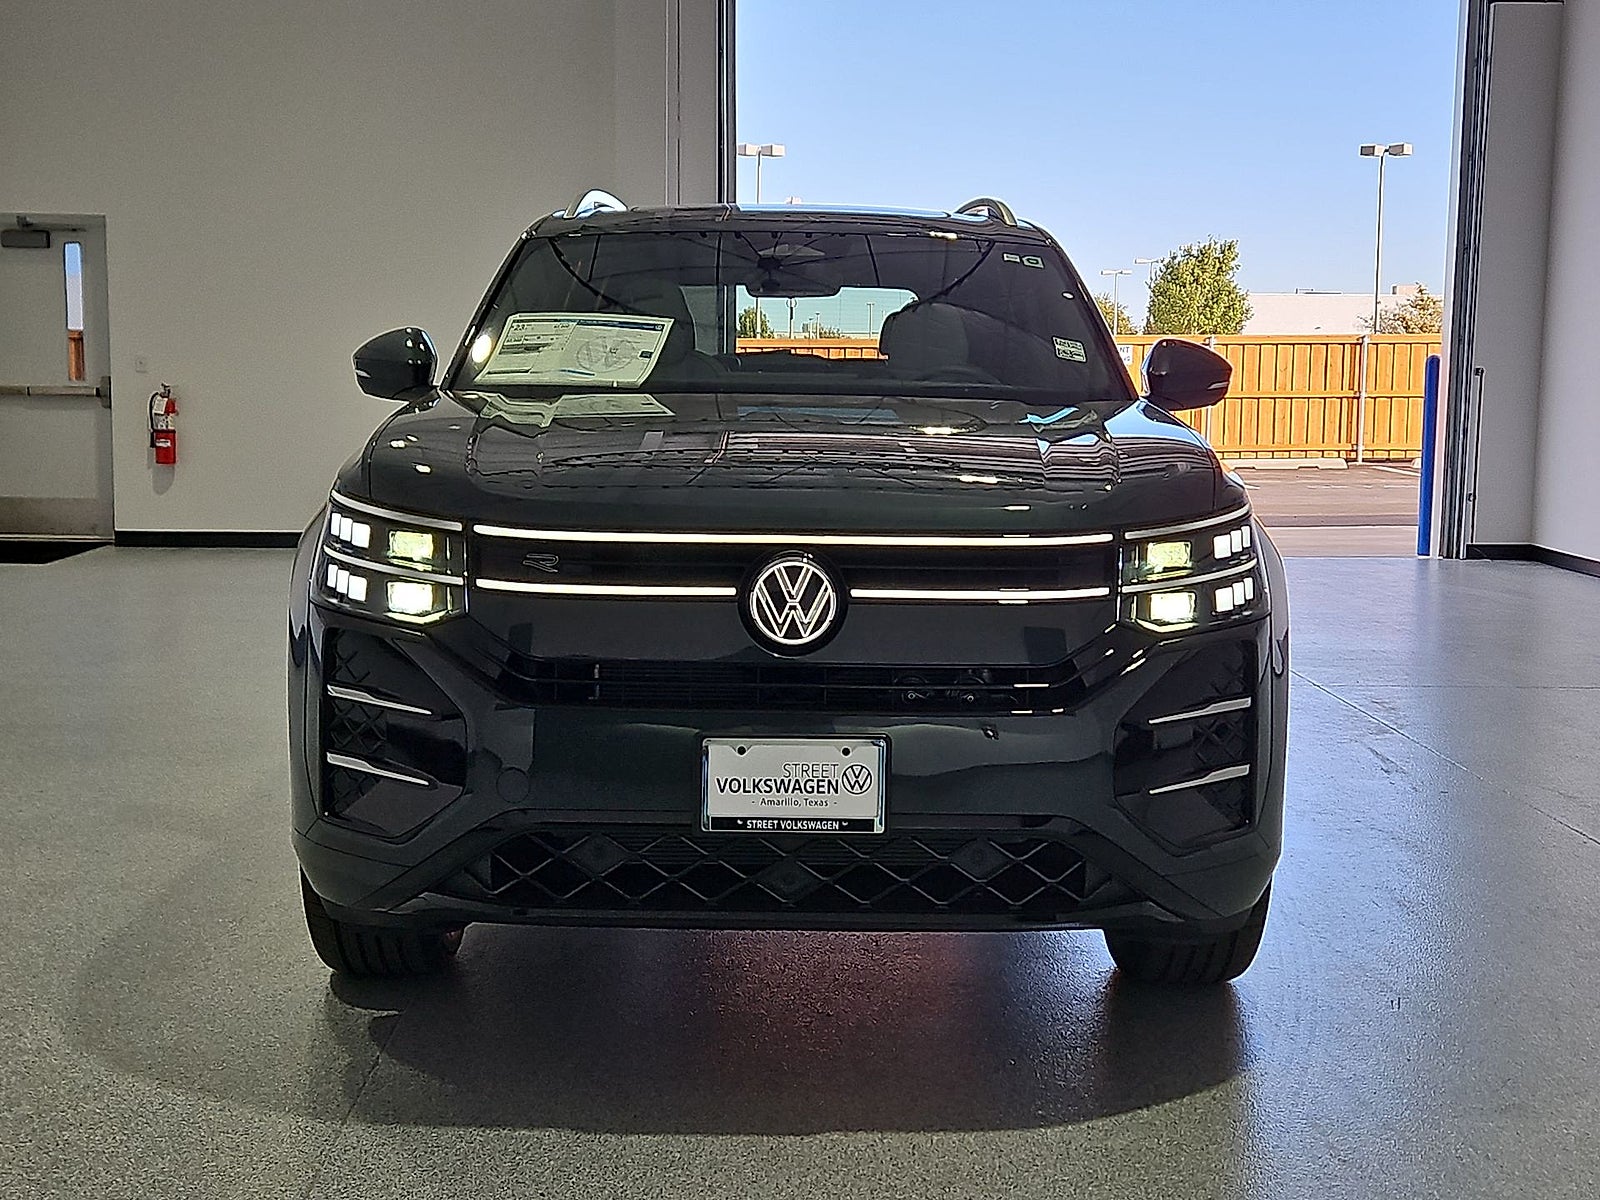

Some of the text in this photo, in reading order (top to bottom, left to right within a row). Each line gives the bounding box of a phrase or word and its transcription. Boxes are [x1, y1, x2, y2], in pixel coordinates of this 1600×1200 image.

[782, 763, 840, 779] STREET
[715, 777, 840, 795] VOLKSWAGEN
[759, 797, 829, 808] Amarillo, Texas
[746, 820, 840, 831] STREET VOLKSWAGEN
